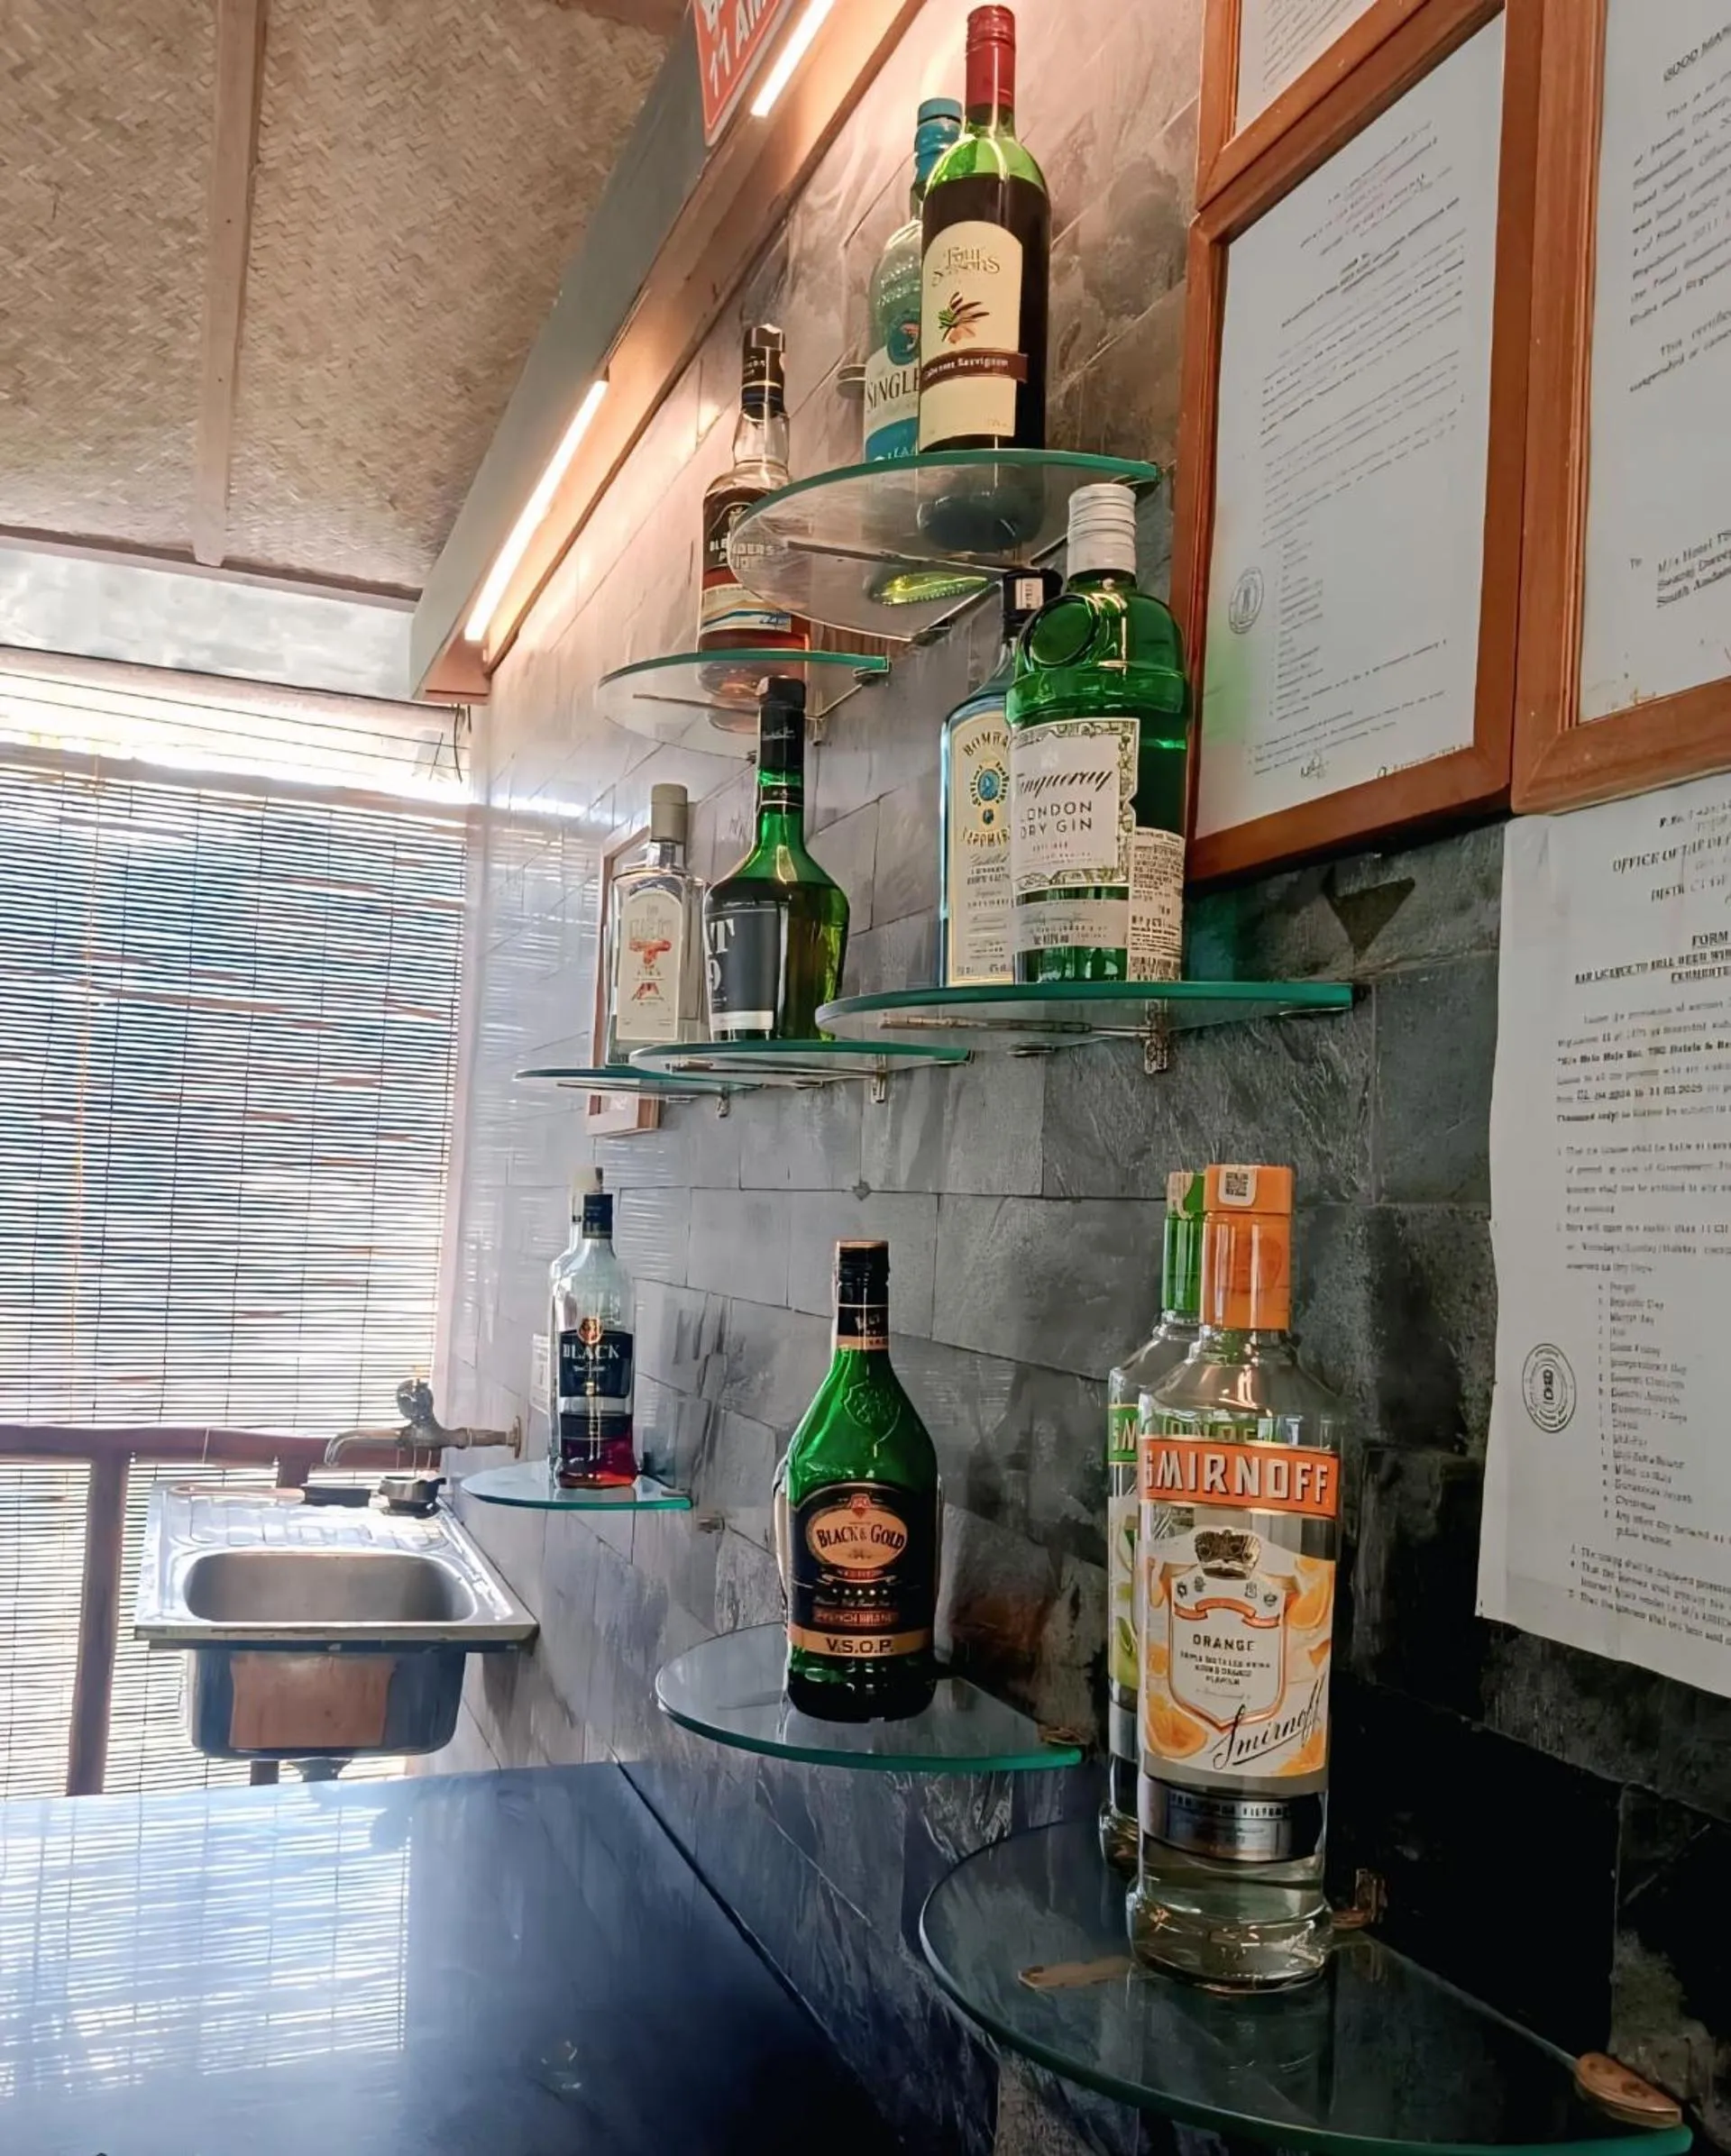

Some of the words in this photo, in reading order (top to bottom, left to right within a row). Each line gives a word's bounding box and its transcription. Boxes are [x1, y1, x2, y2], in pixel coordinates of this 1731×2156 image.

[963, 731, 1010, 757] BOMBA
[1021, 800, 1092, 822] ONDON
[1056, 818, 1092, 833] GIN
[563, 1344, 619, 1359] BLACK
[817, 1524, 858, 1548] BLACK
[871, 1524, 905, 1549] GOLD
[826, 1638, 894, 1654] V.S.O.P.
[1193, 1633, 1254, 1651] ORANGE
